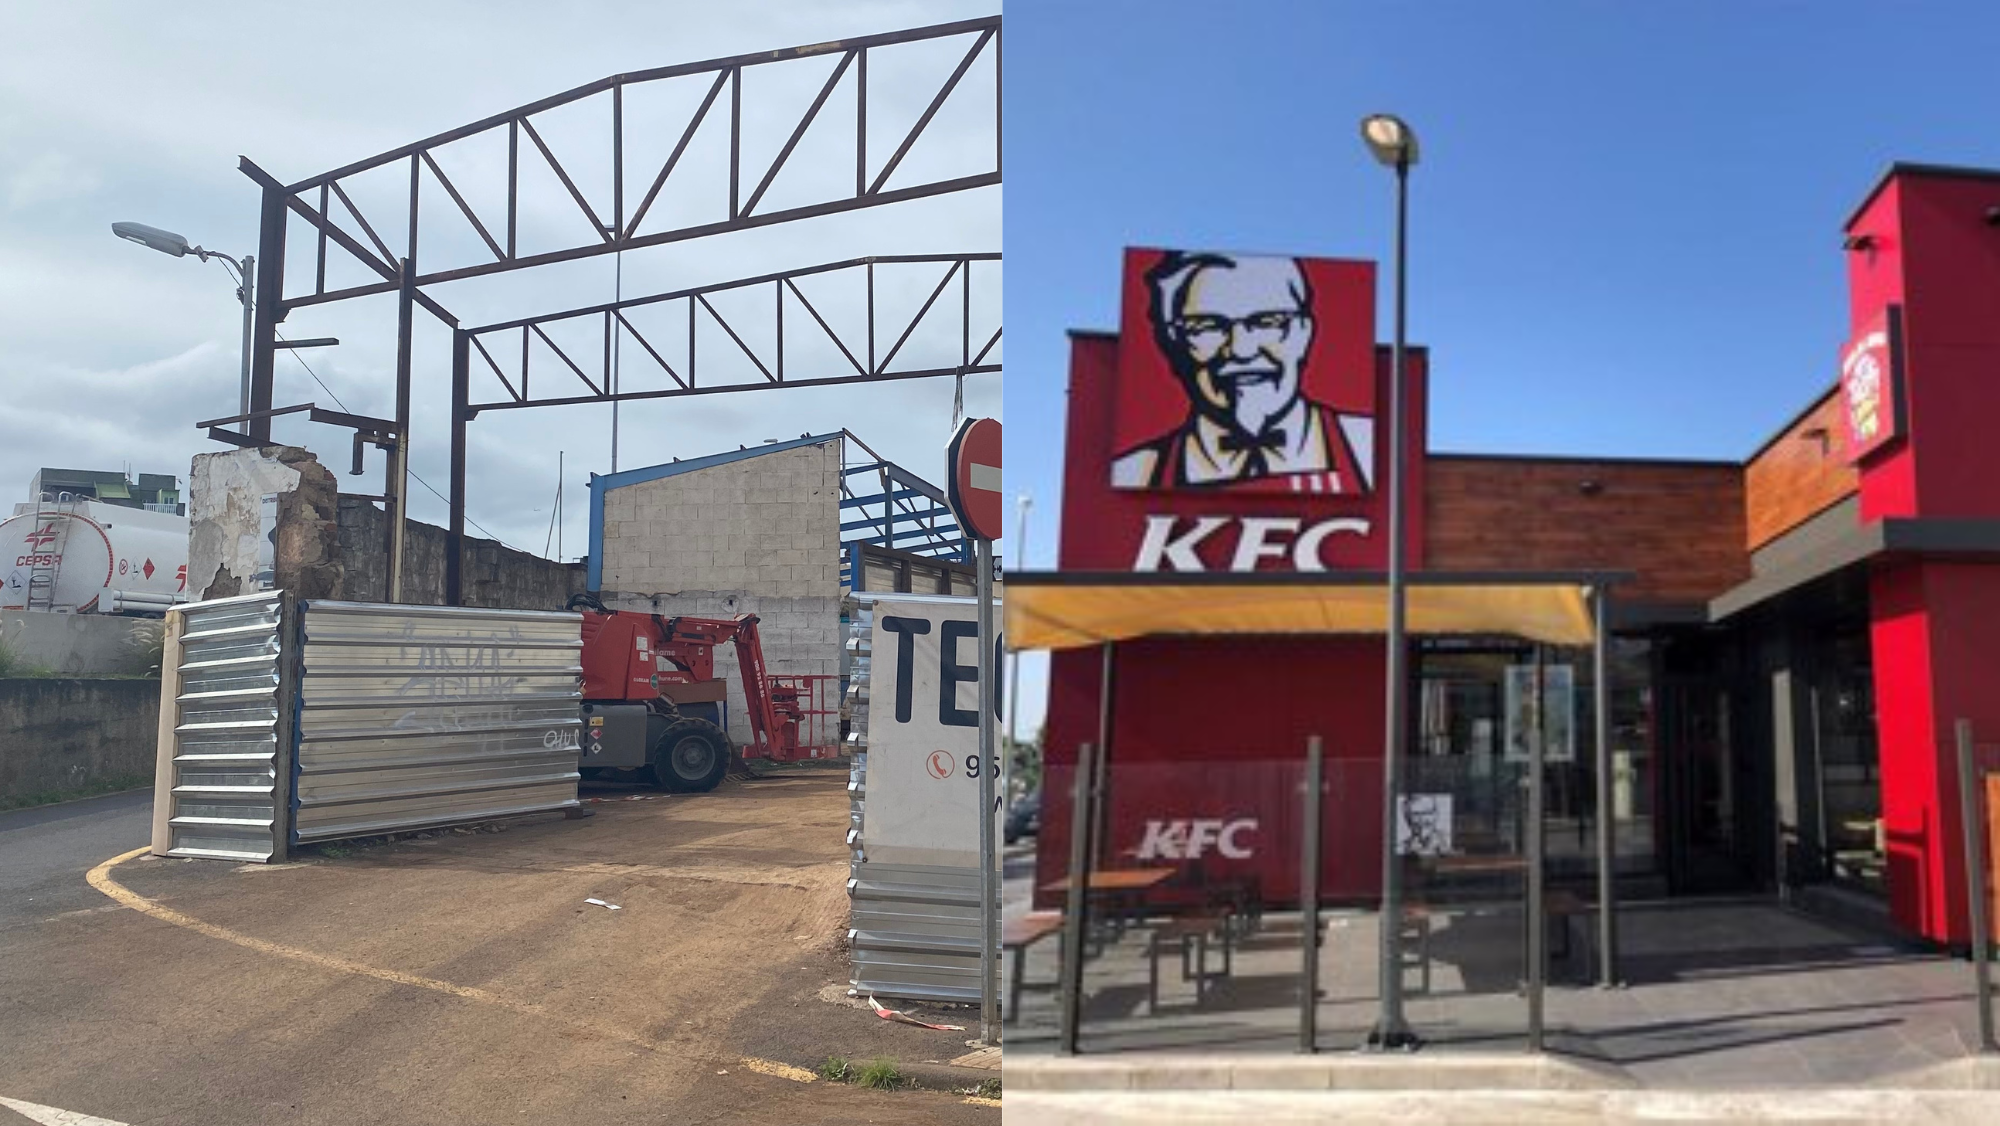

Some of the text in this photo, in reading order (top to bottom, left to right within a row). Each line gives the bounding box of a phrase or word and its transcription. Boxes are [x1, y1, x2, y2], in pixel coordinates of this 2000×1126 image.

[16, 555, 63, 567] CEPSA
[1133, 515, 1371, 572] KFC
[881, 616, 1002, 727] TE
[1137, 818, 1259, 859] KFC
